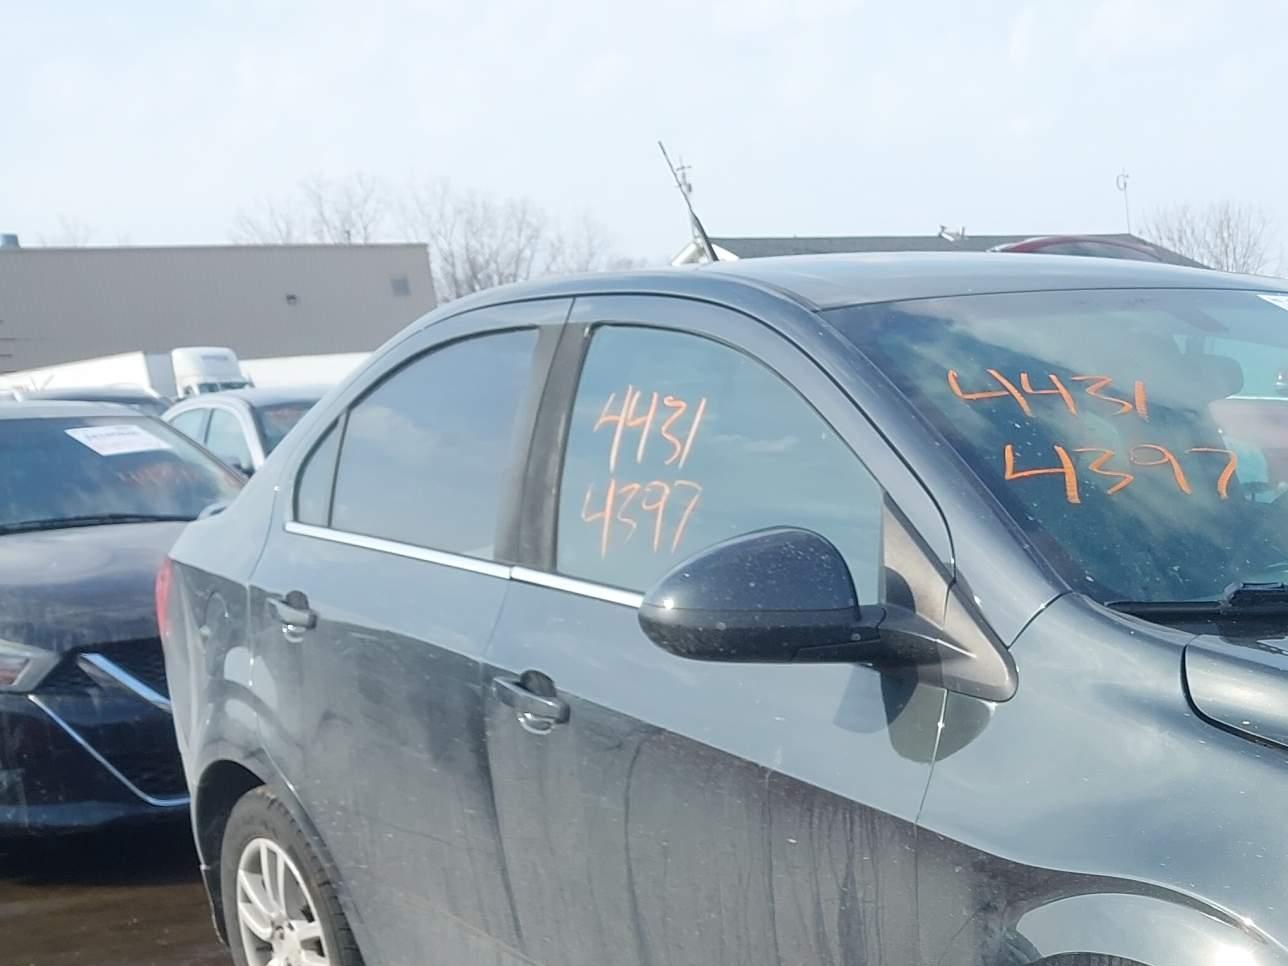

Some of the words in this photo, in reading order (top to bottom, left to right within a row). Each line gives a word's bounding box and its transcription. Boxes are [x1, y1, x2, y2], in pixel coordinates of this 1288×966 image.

[593, 384, 707, 473] 4431
[947, 367, 1149, 424] 4431
[1003, 443, 1239, 504] 4397
[580, 478, 703, 559] 4397
